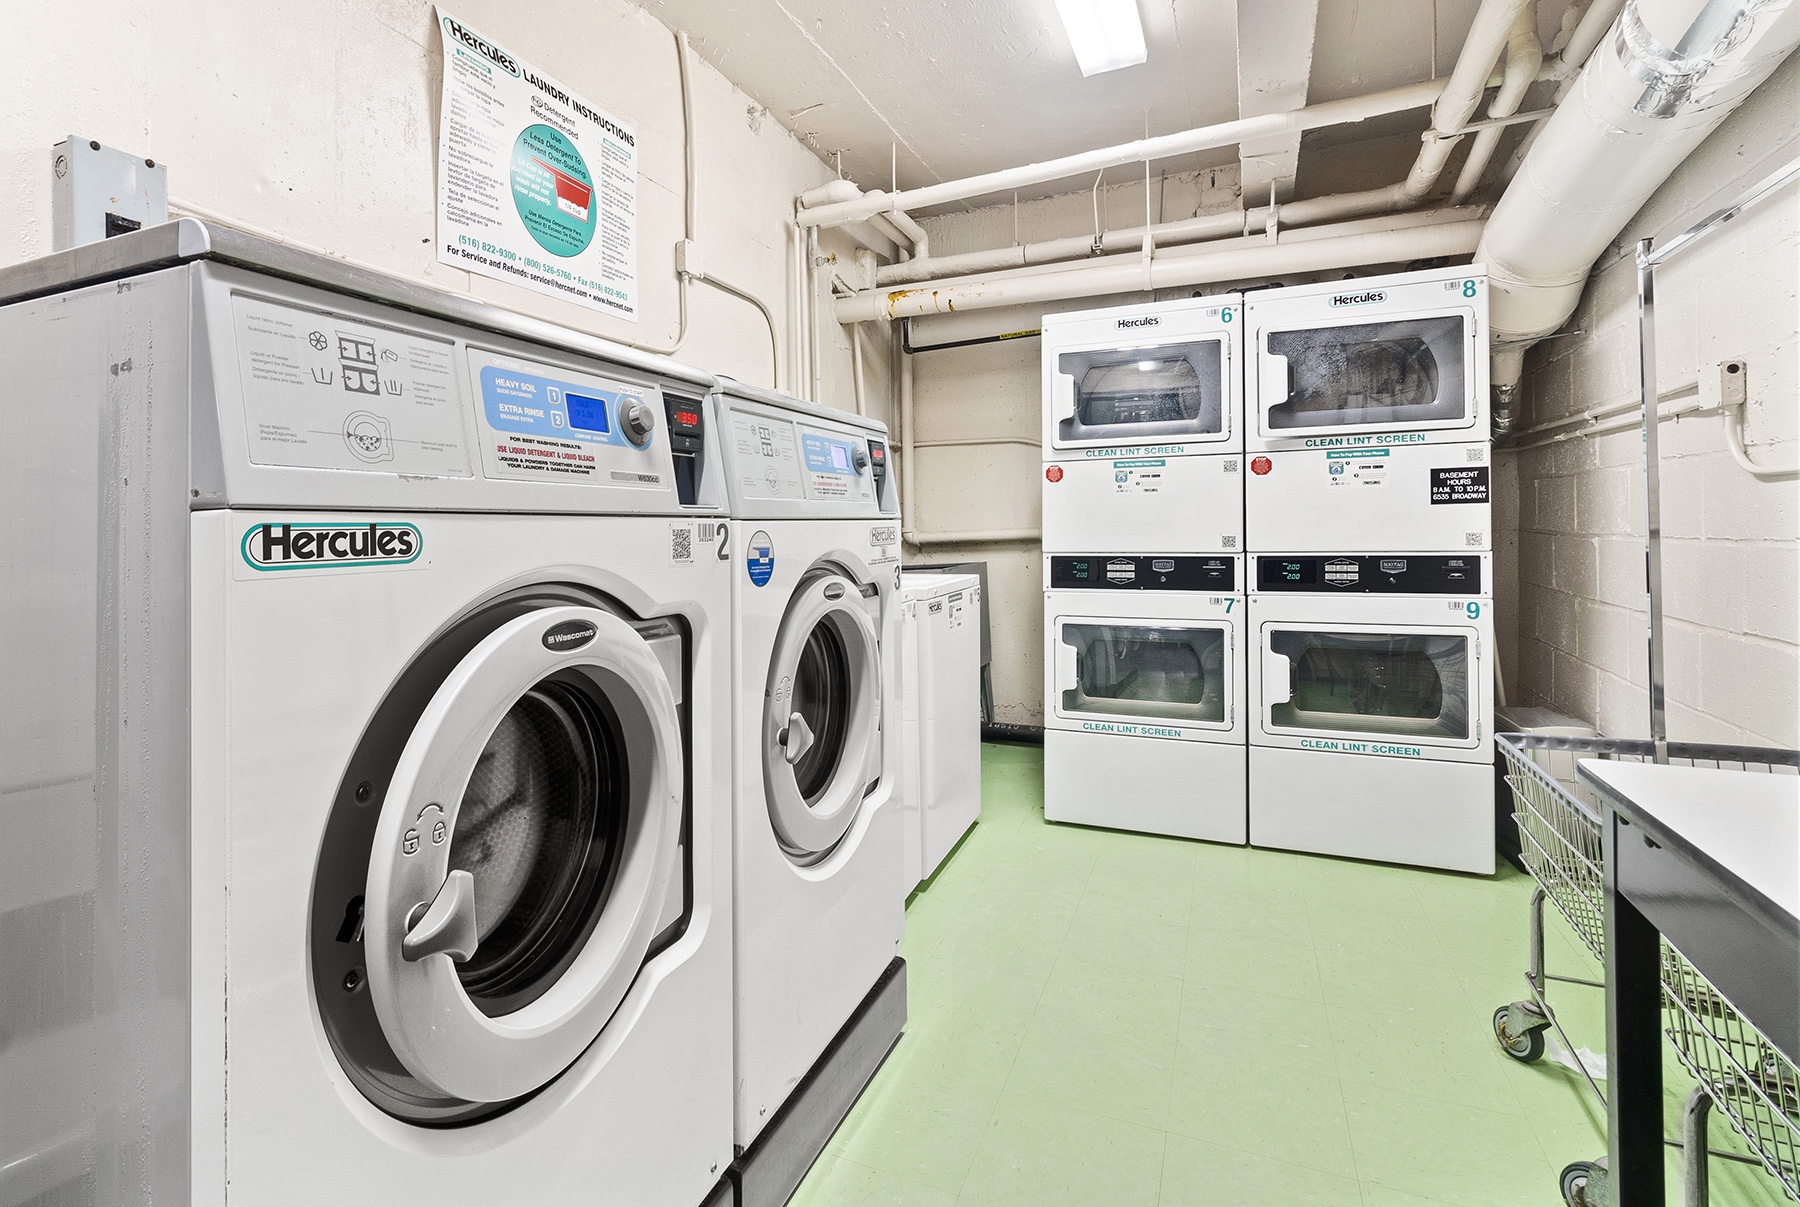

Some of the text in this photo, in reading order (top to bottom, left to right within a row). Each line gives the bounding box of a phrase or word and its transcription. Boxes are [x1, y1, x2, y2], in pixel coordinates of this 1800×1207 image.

[450, 20, 516, 73] Hercules
[523, 69, 634, 146] LAUNDRY INSTRUCTIONS
[544, 103, 575, 127] Detergent
[530, 105, 578, 140] Recommended
[523, 138, 546, 156] Prevent
[550, 133, 562, 144] Use
[530, 132, 581, 165] Less Detergent To
[448, 161, 468, 171] Insertar
[526, 163, 537, 172] Cup
[516, 177, 549, 195] wash will not
[522, 170, 535, 179] need
[542, 179, 554, 188] your
[514, 185, 551, 206] rinse properly.
[525, 215, 542, 226] Prevenir
[548, 225, 562, 234] Exceso
[538, 214, 551, 223] Menos
[552, 220, 572, 232] Detergente
[458, 234, 628, 300] (516) 822-9300 (800) 526-5760 Fax (516) 822-9543
[447, 244, 634, 313] For Service and Refunds: service@hercnet.com www.hercnet.com
[1462, 280, 1476, 298] 8
[1334, 292, 1384, 306] Hercules
[1118, 317, 1159, 328] Hercules
[1221, 307, 1232, 323] 6
[493, 359, 519, 369] OPTIONS
[495, 378, 536, 392] HEAVY SOIL
[511, 390, 532, 398] SATURADO
[499, 404, 544, 417] EXTRA RINSE
[556, 416, 560, 424] 2
[1305, 433, 1426, 448] CLEAN LINT SCREEN
[528, 449, 555, 457] DETERGENT
[1086, 446, 1184, 458] CLEAN LINT SCREEN
[262, 524, 412, 561] Hercules
[716, 523, 729, 560] 2
[872, 528, 896, 542] Hercules
[894, 565, 900, 590] 3
[1224, 598, 1235, 614] 7
[1466, 602, 1480, 620] 9
[555, 629, 594, 642] Wascomat
[1083, 722, 1181, 737] CLEAN LINT SCREEN
[1300, 739, 1420, 756] CLEAN LINT SCREEN
